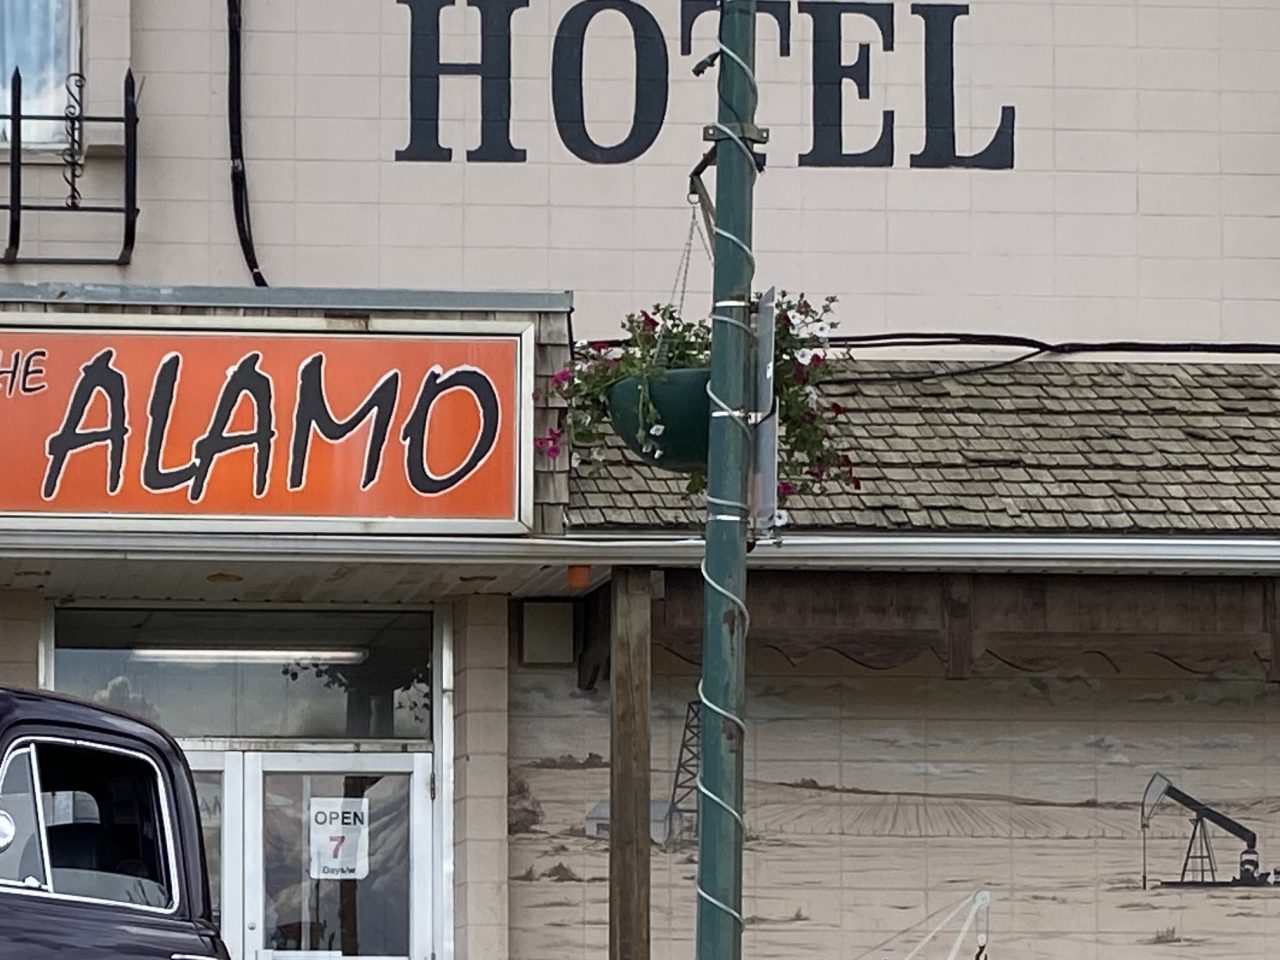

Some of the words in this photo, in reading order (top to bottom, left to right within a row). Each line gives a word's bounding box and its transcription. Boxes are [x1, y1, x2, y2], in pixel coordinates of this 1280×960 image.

[44, 349, 500, 502] ALAMO
[314, 811, 365, 826] OPEN
[329, 835, 346, 859] 7
